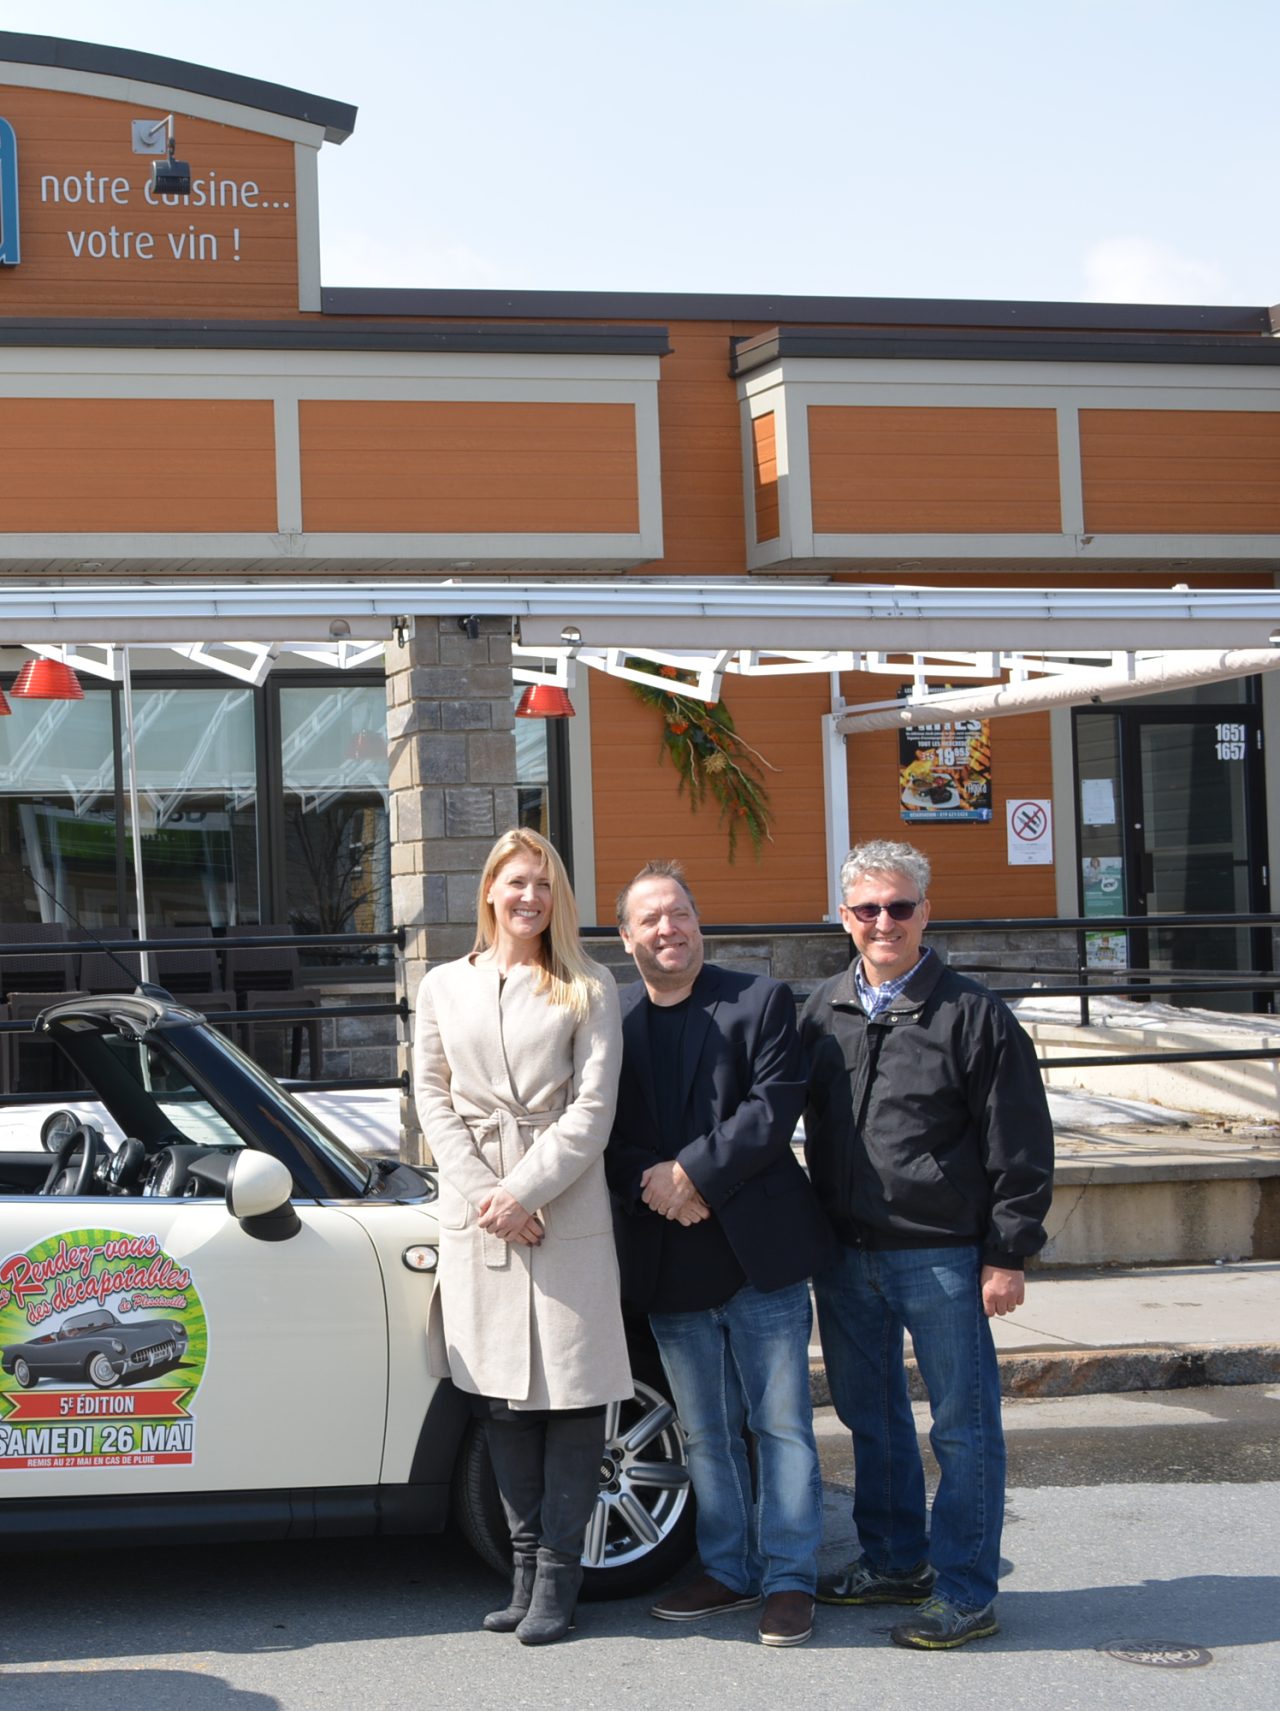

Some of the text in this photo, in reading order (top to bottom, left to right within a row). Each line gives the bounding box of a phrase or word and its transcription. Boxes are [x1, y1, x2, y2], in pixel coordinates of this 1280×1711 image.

[41, 171, 130, 206] notre
[67, 225, 242, 261] votre vin !
[1215, 723, 1245, 741] 1651
[1215, 742, 1245, 760] 1657
[0, 1235, 158, 1308] Rendez-vous
[27, 1256, 191, 1323] des décapotables
[119, 1293, 187, 1312] de Plessisville
[76, 1394, 134, 1414] ÉDITION
[100, 1425, 133, 1453] 26
[141, 1423, 192, 1452] MAI
[27, 1455, 155, 1467] REMIS AU 27 MAI EN CAS DE PLUIE
